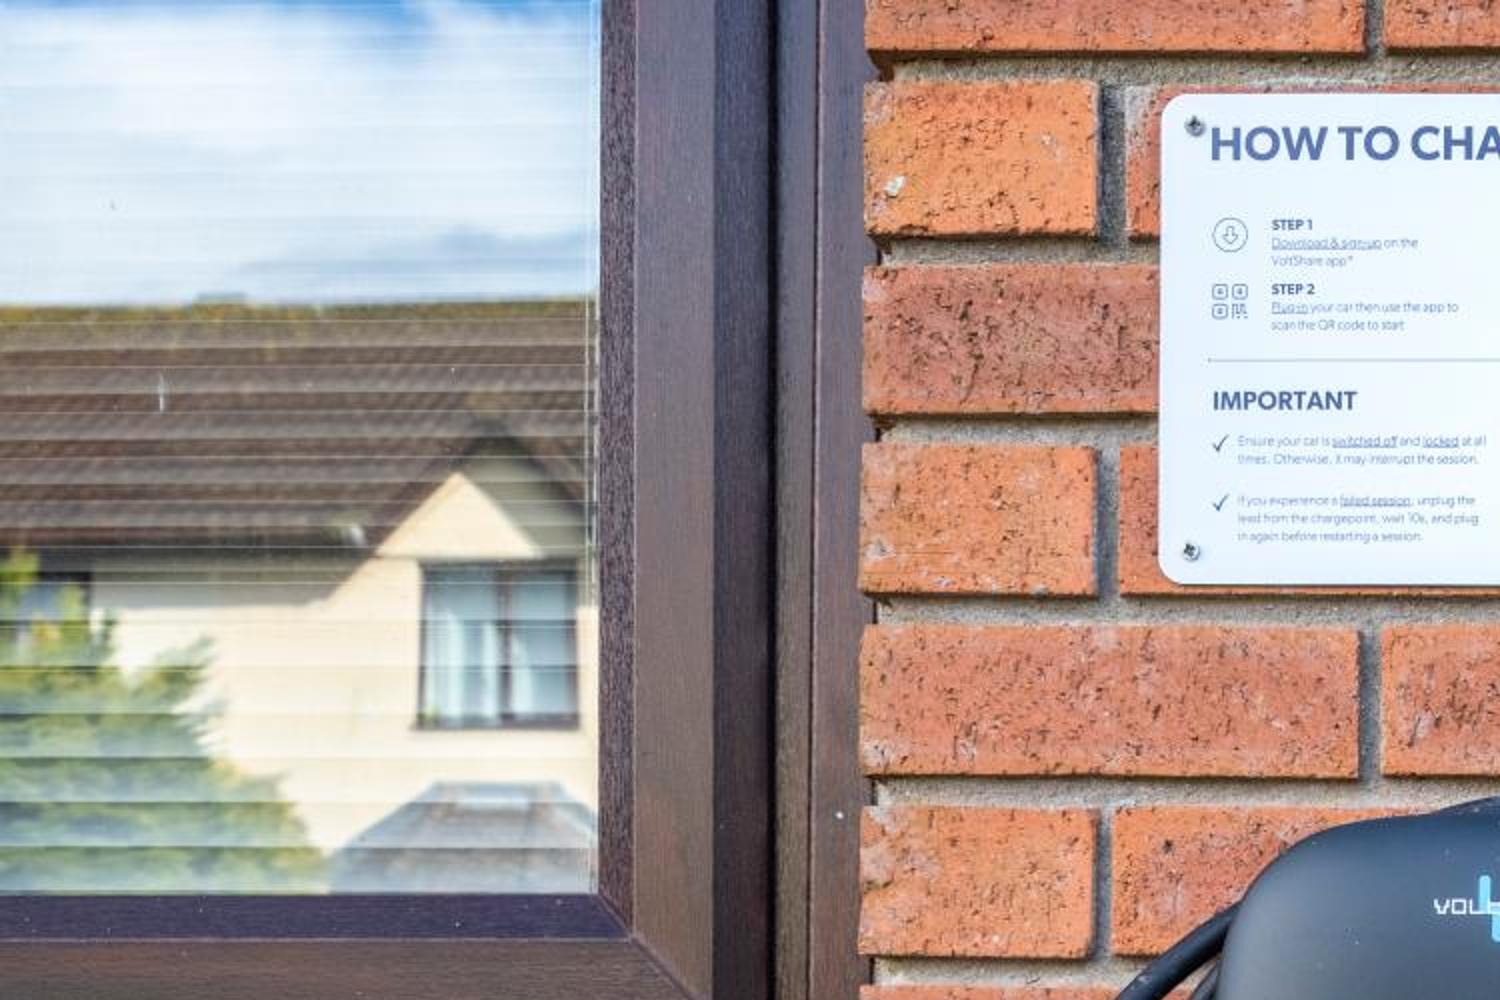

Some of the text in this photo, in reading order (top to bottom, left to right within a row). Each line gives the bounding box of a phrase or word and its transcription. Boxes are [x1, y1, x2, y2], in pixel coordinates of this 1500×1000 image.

[1211, 126, 1328, 162] HOW
[1337, 126, 1399, 162] TO
[1272, 219, 1313, 230] STEP 1
[1272, 238, 1328, 250] Download
[1331, 238, 1339, 250] &
[1384, 238, 1398, 250] on
[1400, 238, 1418, 250] the
[1272, 256, 1323, 266] VoltShare
[1272, 284, 1315, 295] STEP 2
[1310, 304, 1338, 314] your
[1340, 304, 1352, 312] car
[1356, 302, 1382, 312] then
[1384, 304, 1401, 312] use
[1403, 302, 1420, 312] the
[1422, 304, 1444, 314] app
[1448, 302, 1459, 312] to
[1272, 320, 1404, 331] scan the QR code to start
[1214, 391, 1357, 410] IMPORTANT
[1237, 436, 1275, 446] Ensure
[1277, 438, 1301, 448] your
[1303, 437, 1319, 446] car
[1322, 436, 1330, 446] is
[1332, 435, 1383, 448] switched
[1399, 436, 1420, 446] and
[1422, 435, 1459, 448] locked
[1462, 436, 1473, 446] at
[1474, 436, 1486, 446] all
[1237, 454, 1478, 465] times. Otherwise, it may interrupt the session.
[1246, 498, 1267, 507] you
[1269, 496, 1329, 507] experience
[1332, 497, 1337, 505] a
[1417, 496, 1455, 507] unplug
[1457, 495, 1475, 507] the
[1237, 513, 1261, 523] lead
[1263, 513, 1288, 523] from
[1291, 513, 1308, 523] the
[1311, 514, 1379, 525] chargepoint,
[1382, 513, 1404, 523] wait
[1431, 513, 1452, 523] and
[1454, 514, 1479, 526] plug
[1237, 531, 1248, 541] in
[1250, 532, 1279, 543] again
[1282, 531, 1317, 541] before
[1320, 531, 1370, 544] restarting
[1380, 531, 1422, 541] session.
